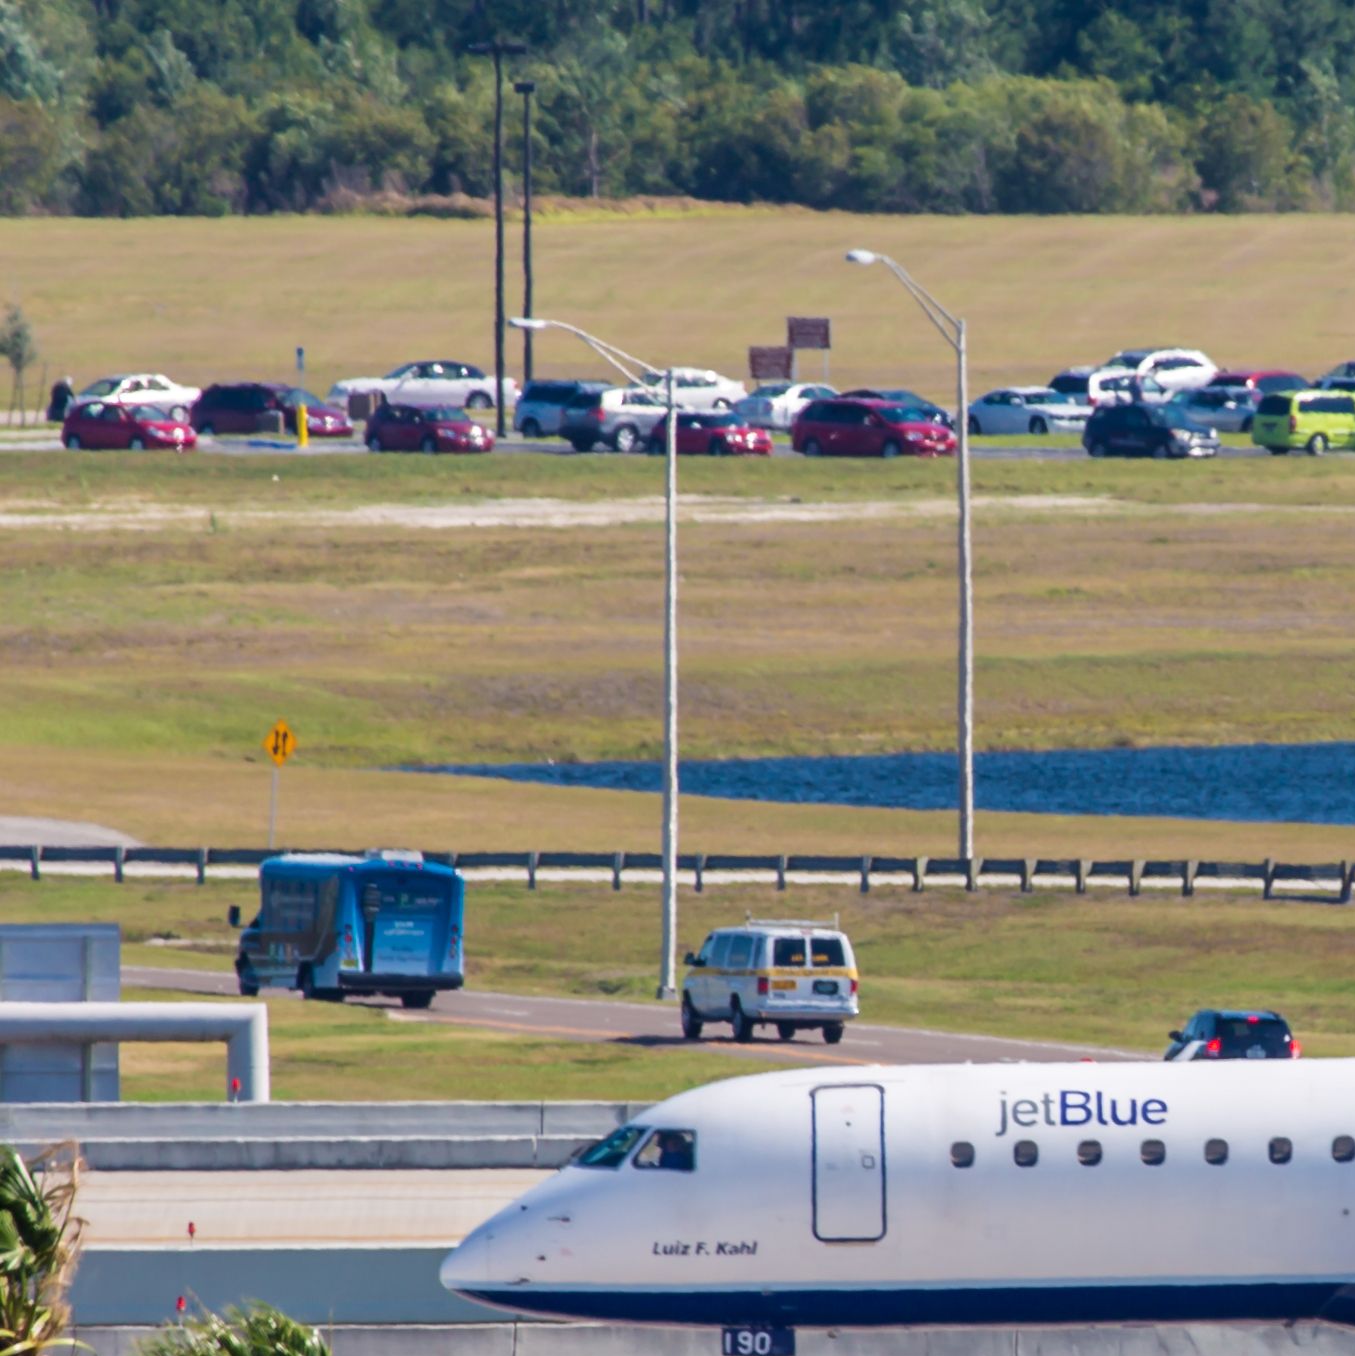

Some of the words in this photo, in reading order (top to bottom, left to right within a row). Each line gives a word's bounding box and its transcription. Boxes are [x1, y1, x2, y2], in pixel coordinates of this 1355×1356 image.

[995, 1090, 1168, 1137] jetBlue
[653, 1240, 690, 1256] Luiz
[695, 1241, 711, 1256] F.
[716, 1240, 758, 1256] Kahl
[725, 1330, 771, 1355] 190
